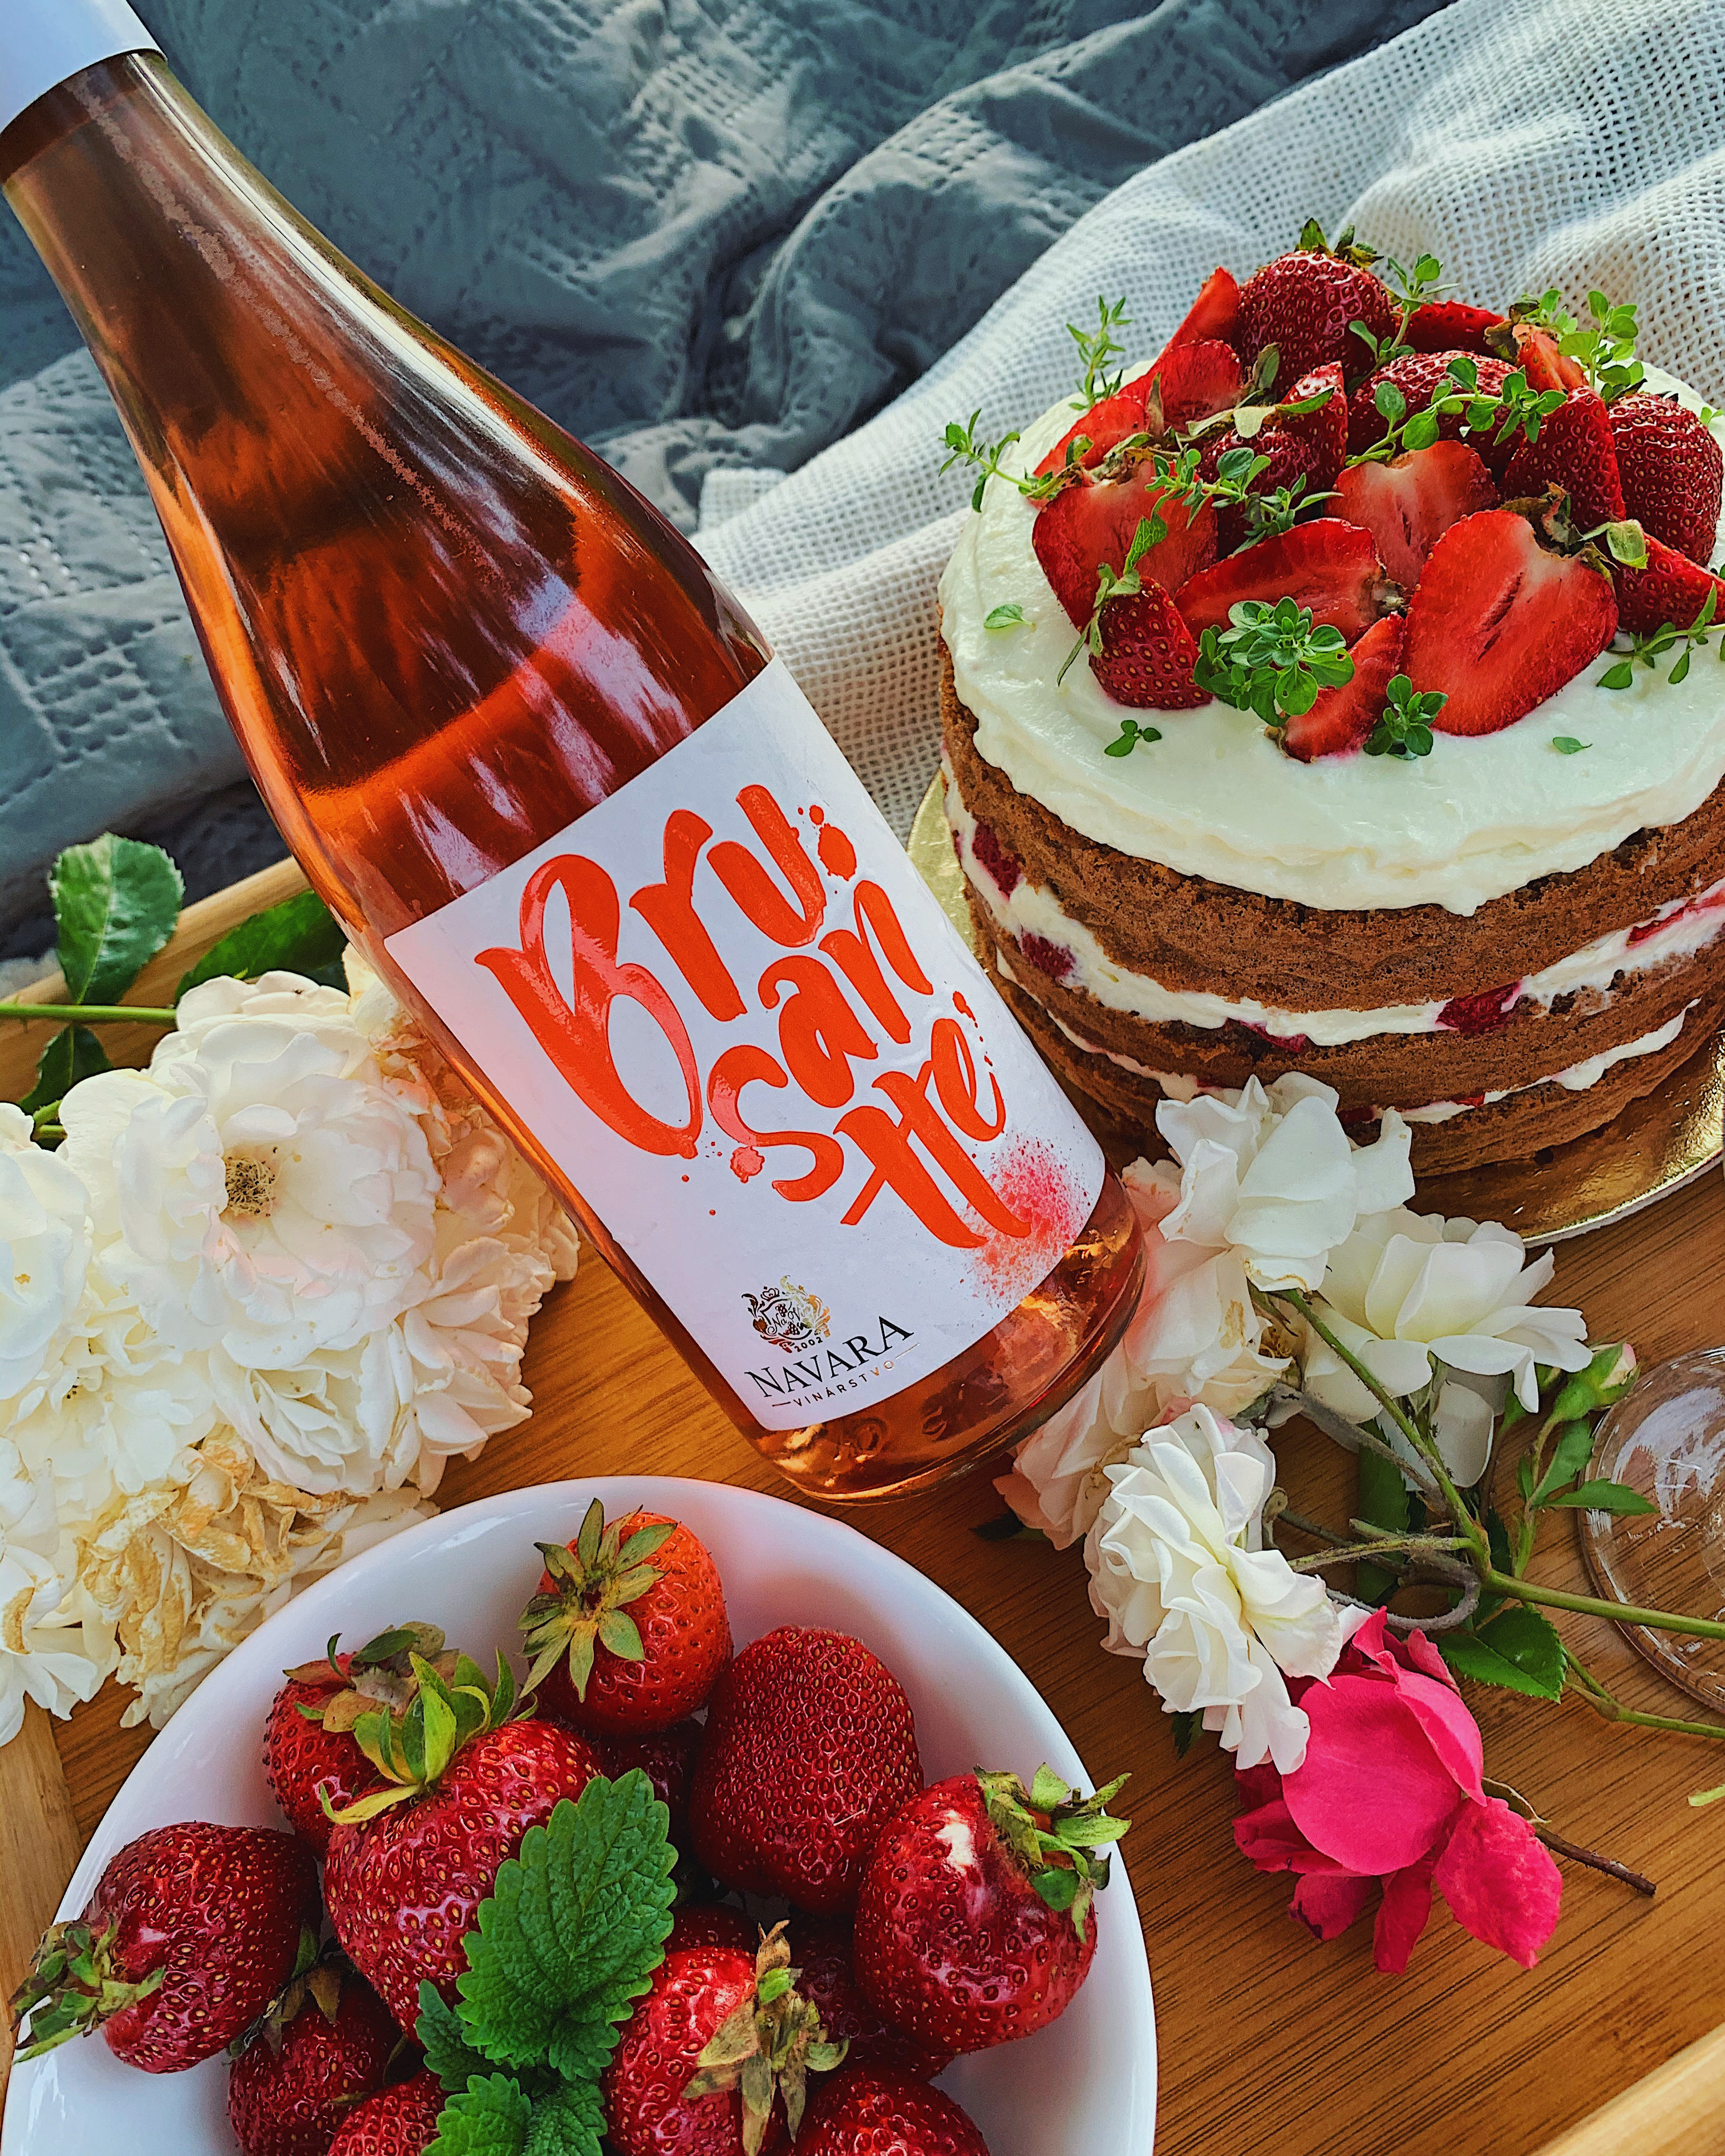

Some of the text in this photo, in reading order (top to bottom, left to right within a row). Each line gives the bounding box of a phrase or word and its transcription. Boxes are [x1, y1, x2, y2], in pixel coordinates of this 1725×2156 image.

[475, 784, 827, 1160] Bru
[707, 879, 934, 1202] san
[744, 1316, 914, 1397] NAVARA
[793, 1360, 894, 1407] VINÁRSTVO
[795, 1336, 823, 1352] 2002
